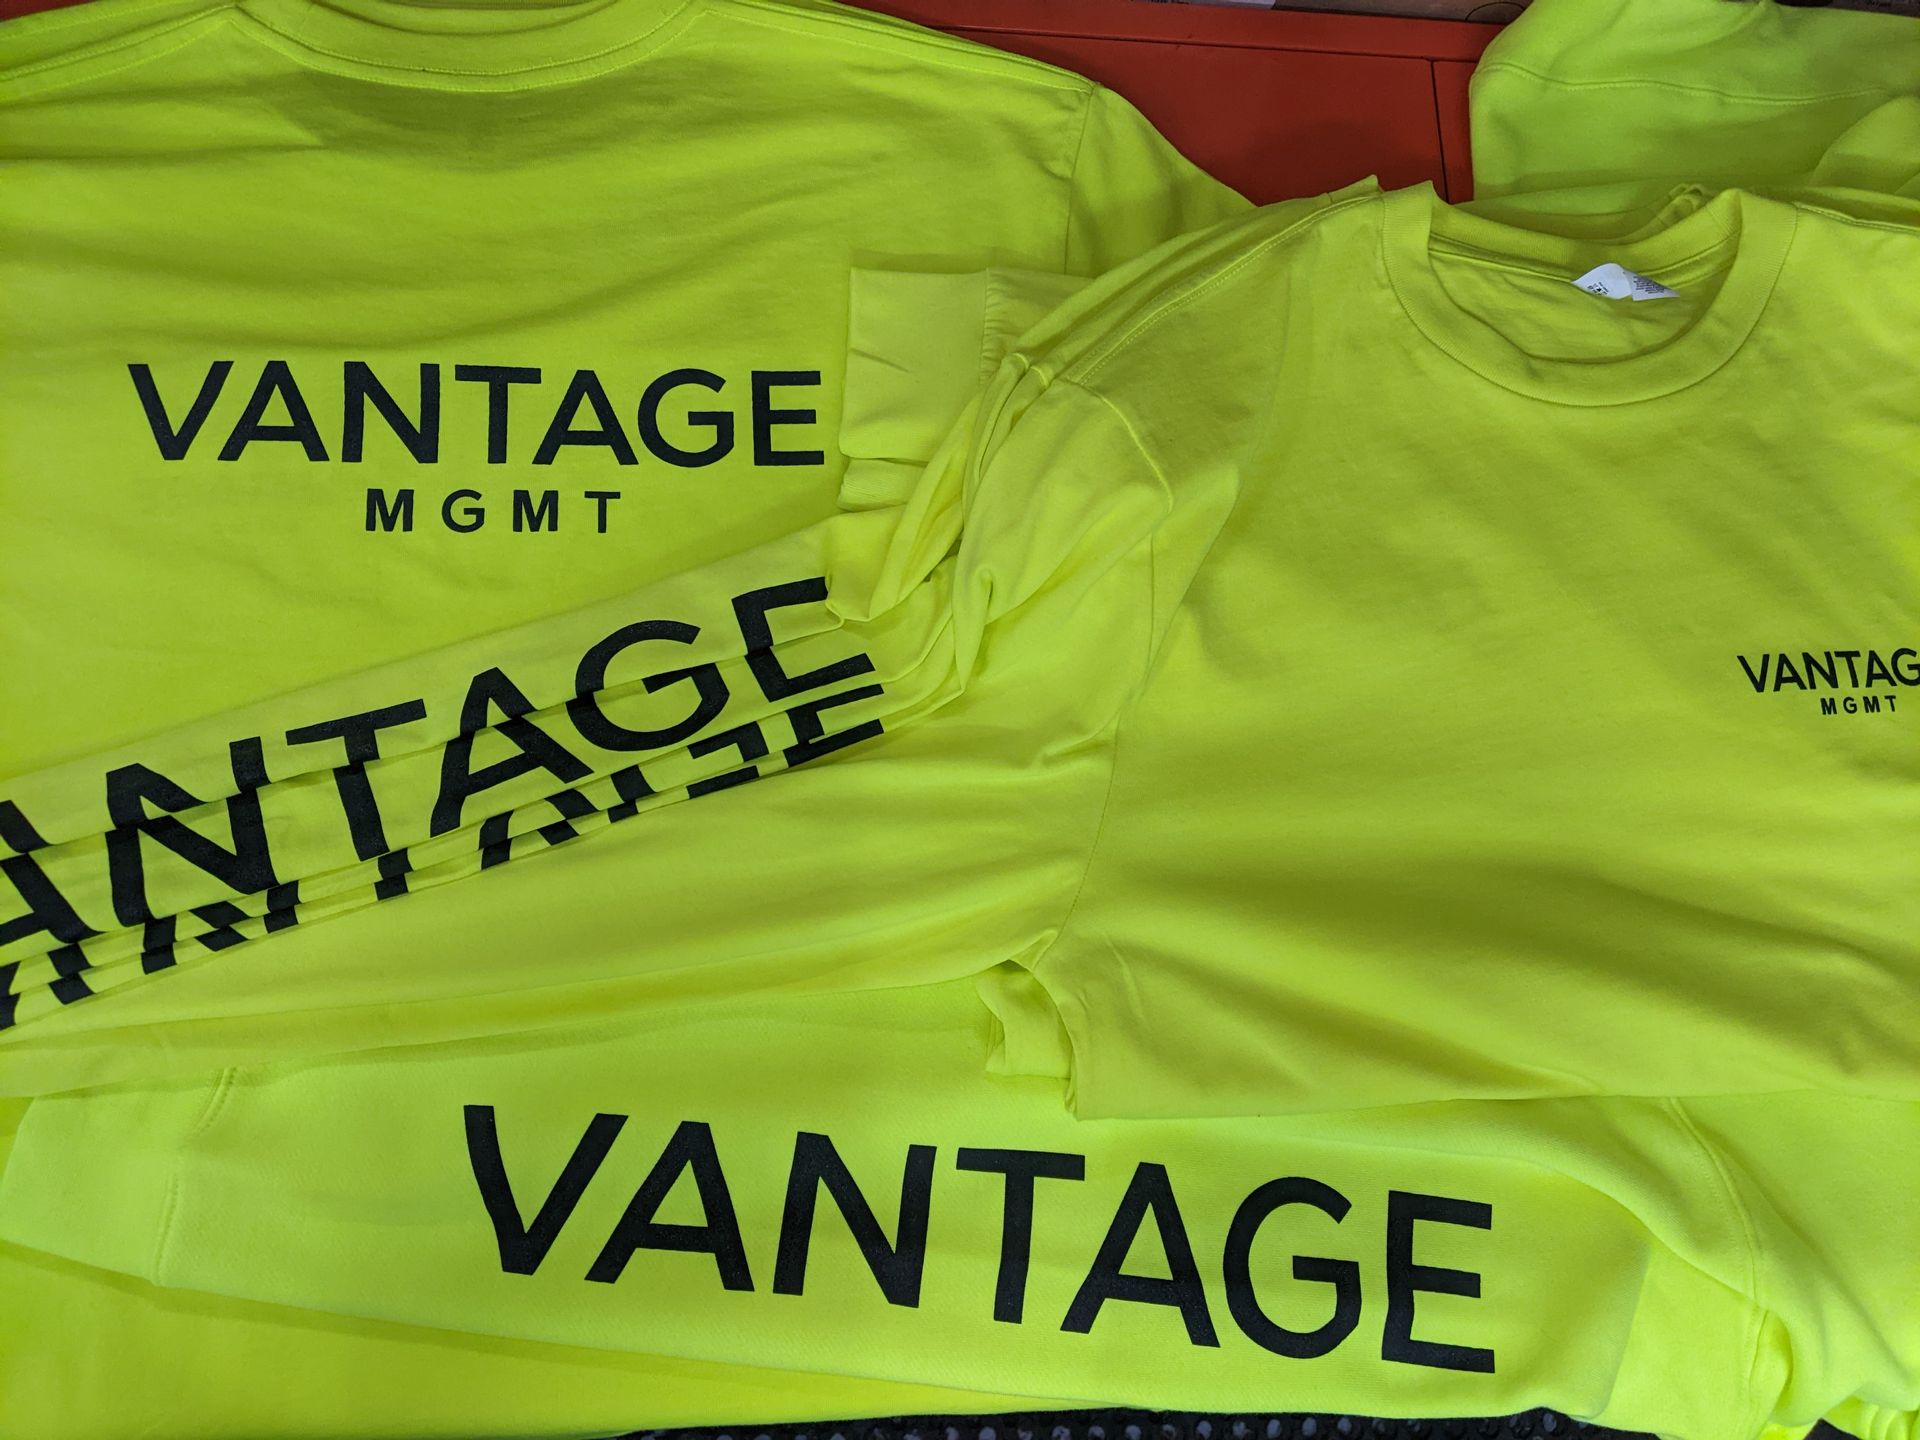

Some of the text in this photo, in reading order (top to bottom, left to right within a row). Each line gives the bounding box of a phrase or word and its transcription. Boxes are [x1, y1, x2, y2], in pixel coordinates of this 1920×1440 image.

[128, 361, 824, 467] VANTAGE
[366, 489, 620, 533] MGMT
[1737, 648, 1920, 692] VANTAG
[1820, 694, 1897, 715] MGMT
[464, 1105, 1496, 1373] VANTAGE
